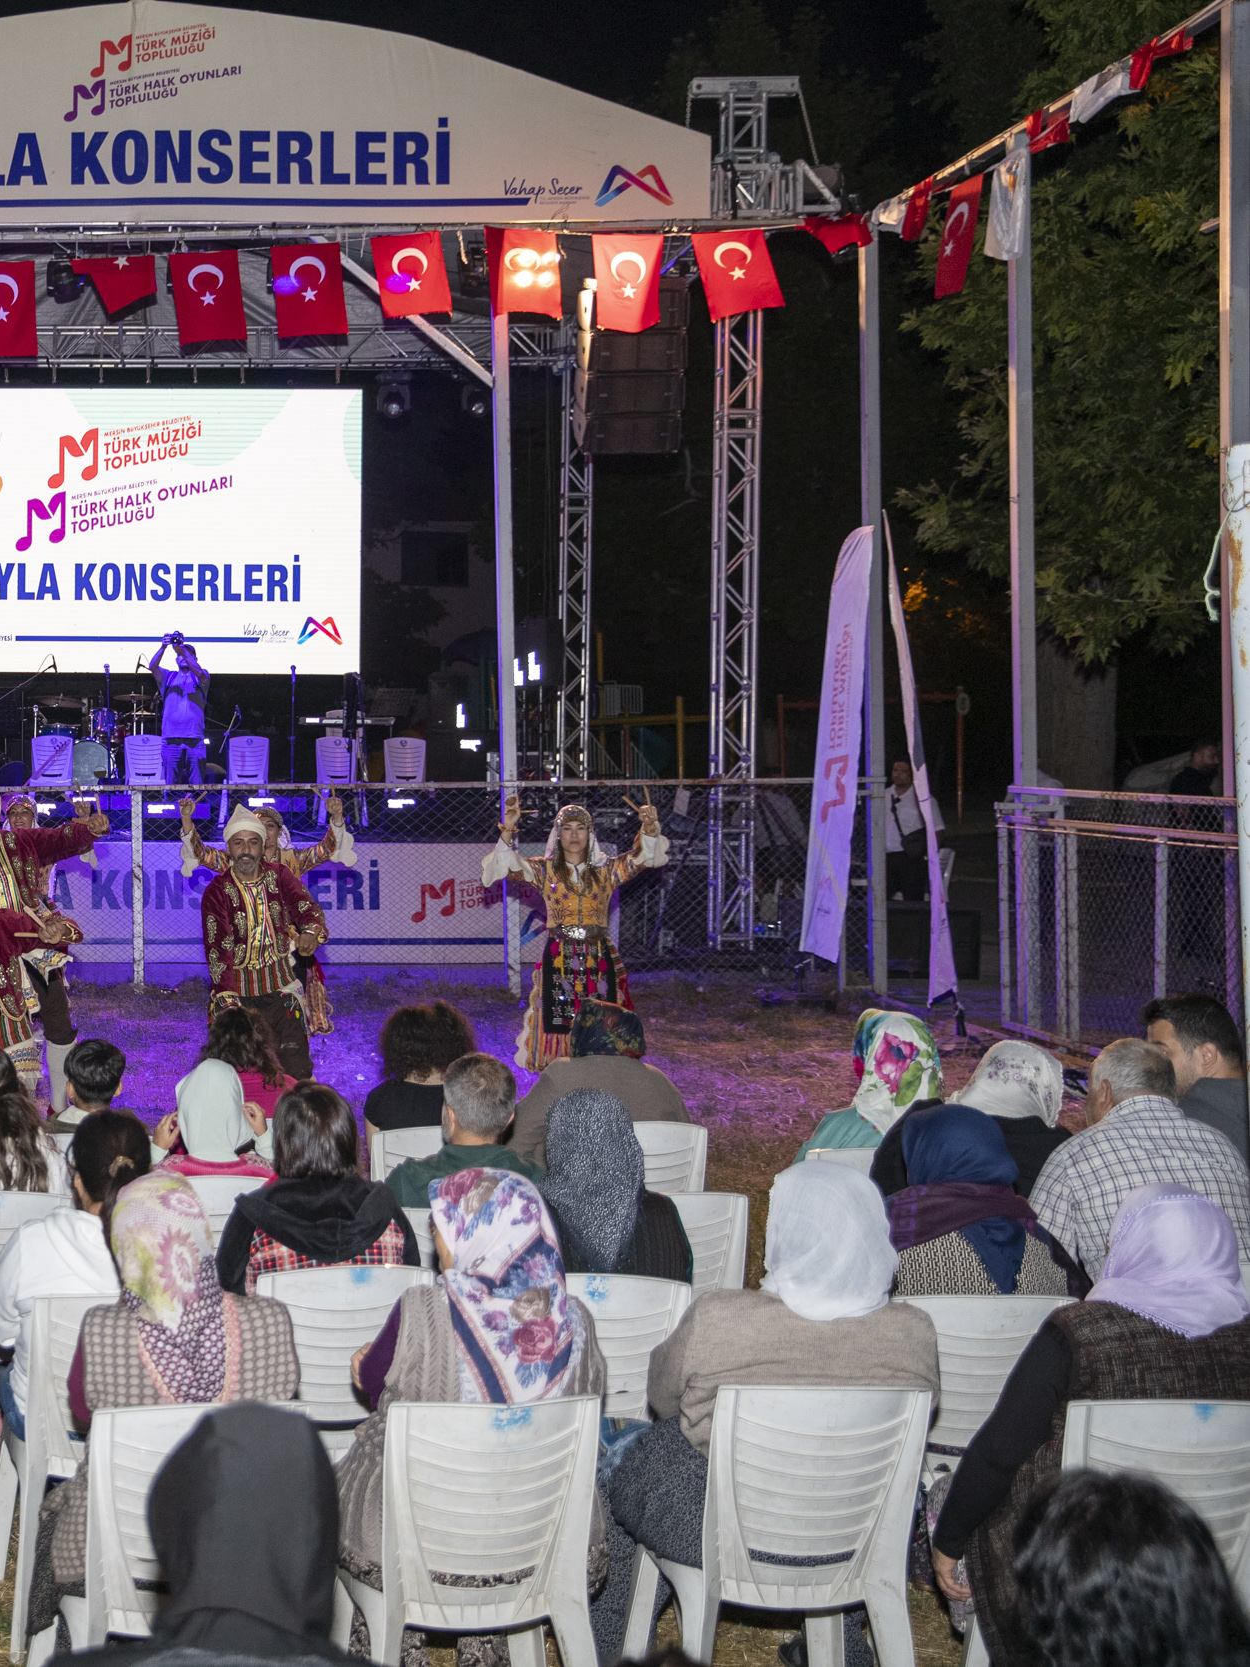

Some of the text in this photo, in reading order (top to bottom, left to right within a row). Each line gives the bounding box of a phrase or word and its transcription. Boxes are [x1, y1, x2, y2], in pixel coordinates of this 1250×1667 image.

[136, 26, 216, 52] TÜRK MÜZİĞİ
[136, 42, 205, 64] TOPLULUĞU
[110, 65, 242, 98] TÜRK HALK OYUNLARI
[110, 87, 178, 109] TOPLULUĞU
[70, 117, 451, 186] KONSERLERİ
[503, 177, 546, 204] Vahap
[104, 420, 201, 455] TÜRK MÜZİĞİ
[104, 442, 188, 471] TOPLULUĞU
[71, 475, 233, 518] TÜRK HALK OYUNLARI
[71, 506, 155, 534] TOPLULUĞU
[74, 554, 301, 602] KONSERLERİ
[459, 884, 492, 899] TÜRK
